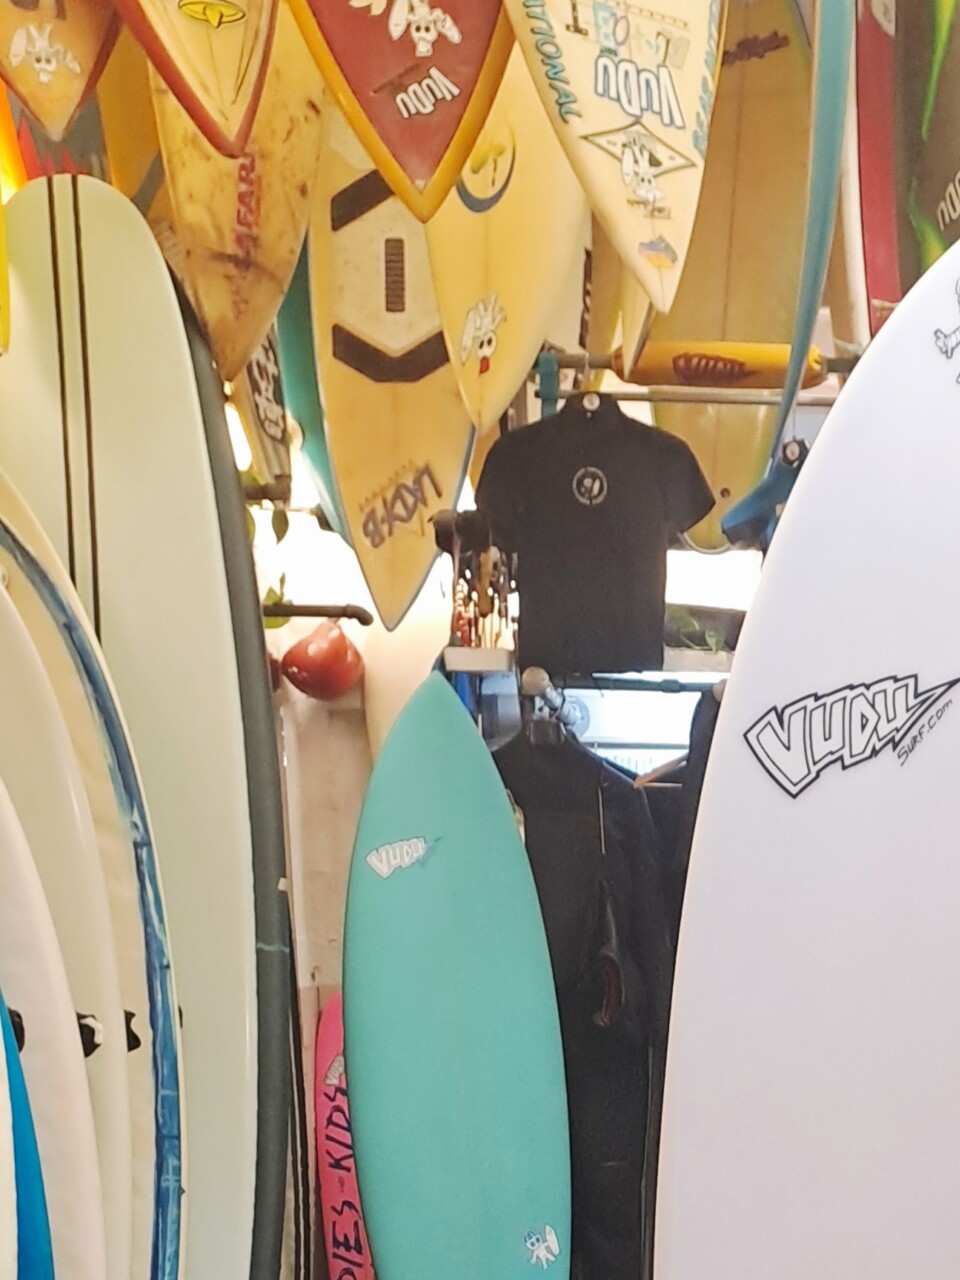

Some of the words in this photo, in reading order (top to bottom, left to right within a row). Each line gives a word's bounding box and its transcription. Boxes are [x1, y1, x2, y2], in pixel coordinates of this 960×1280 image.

[744, 673, 940, 799] VUDU
[366, 836, 430, 879] VUDU
[322, 1083, 355, 1174] KIDS
